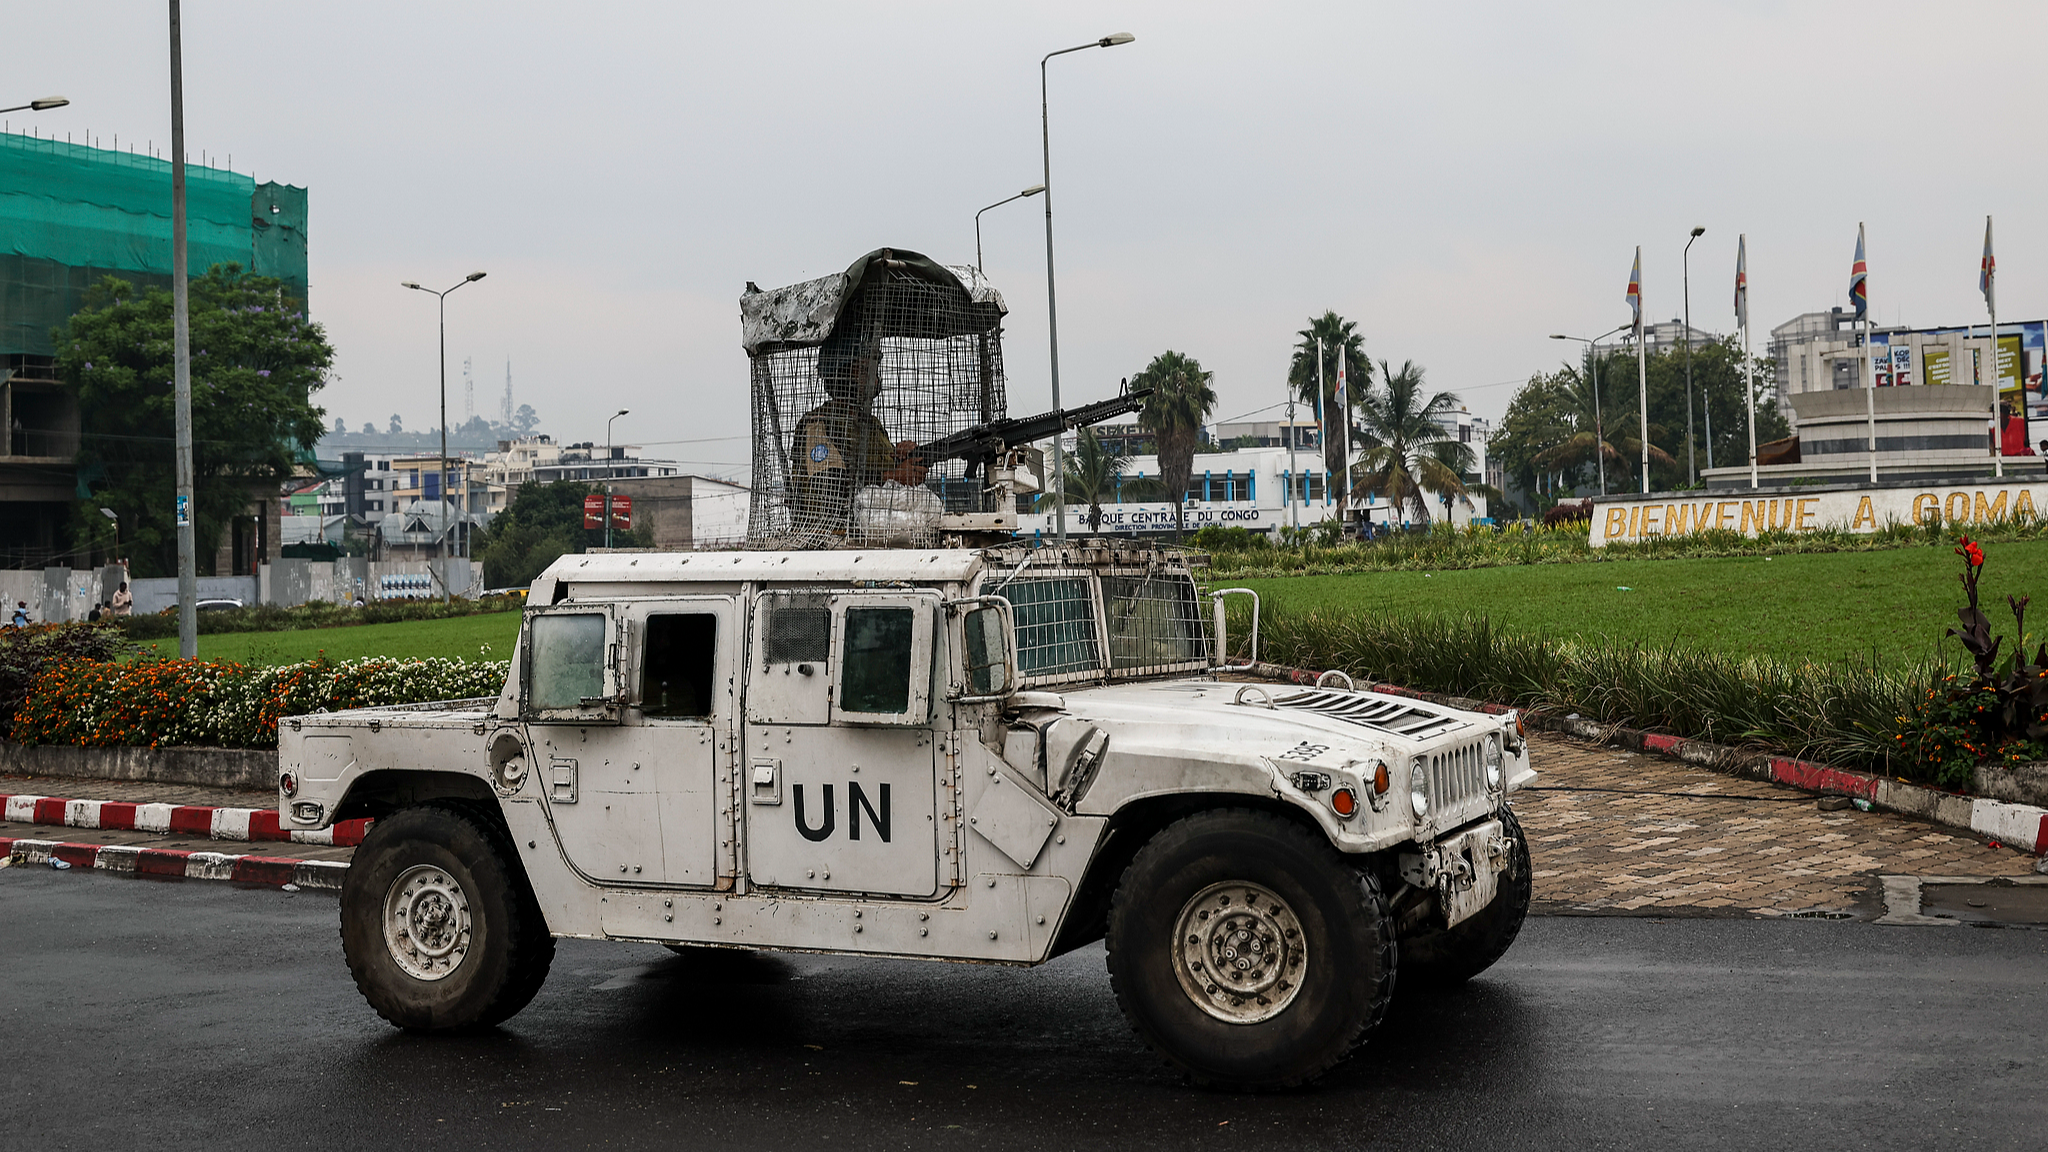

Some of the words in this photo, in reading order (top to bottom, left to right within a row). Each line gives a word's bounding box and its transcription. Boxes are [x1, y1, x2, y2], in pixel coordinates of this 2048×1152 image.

[1131, 511, 1190, 524] CENTRAE
[1198, 511, 1213, 521] DU
[1221, 510, 1259, 521] CONGO
[1604, 498, 1820, 539] BIENVENUE
[1852, 495, 1876, 529] A
[1912, 489, 2036, 527] GOMA
[792, 780, 892, 843] UN
